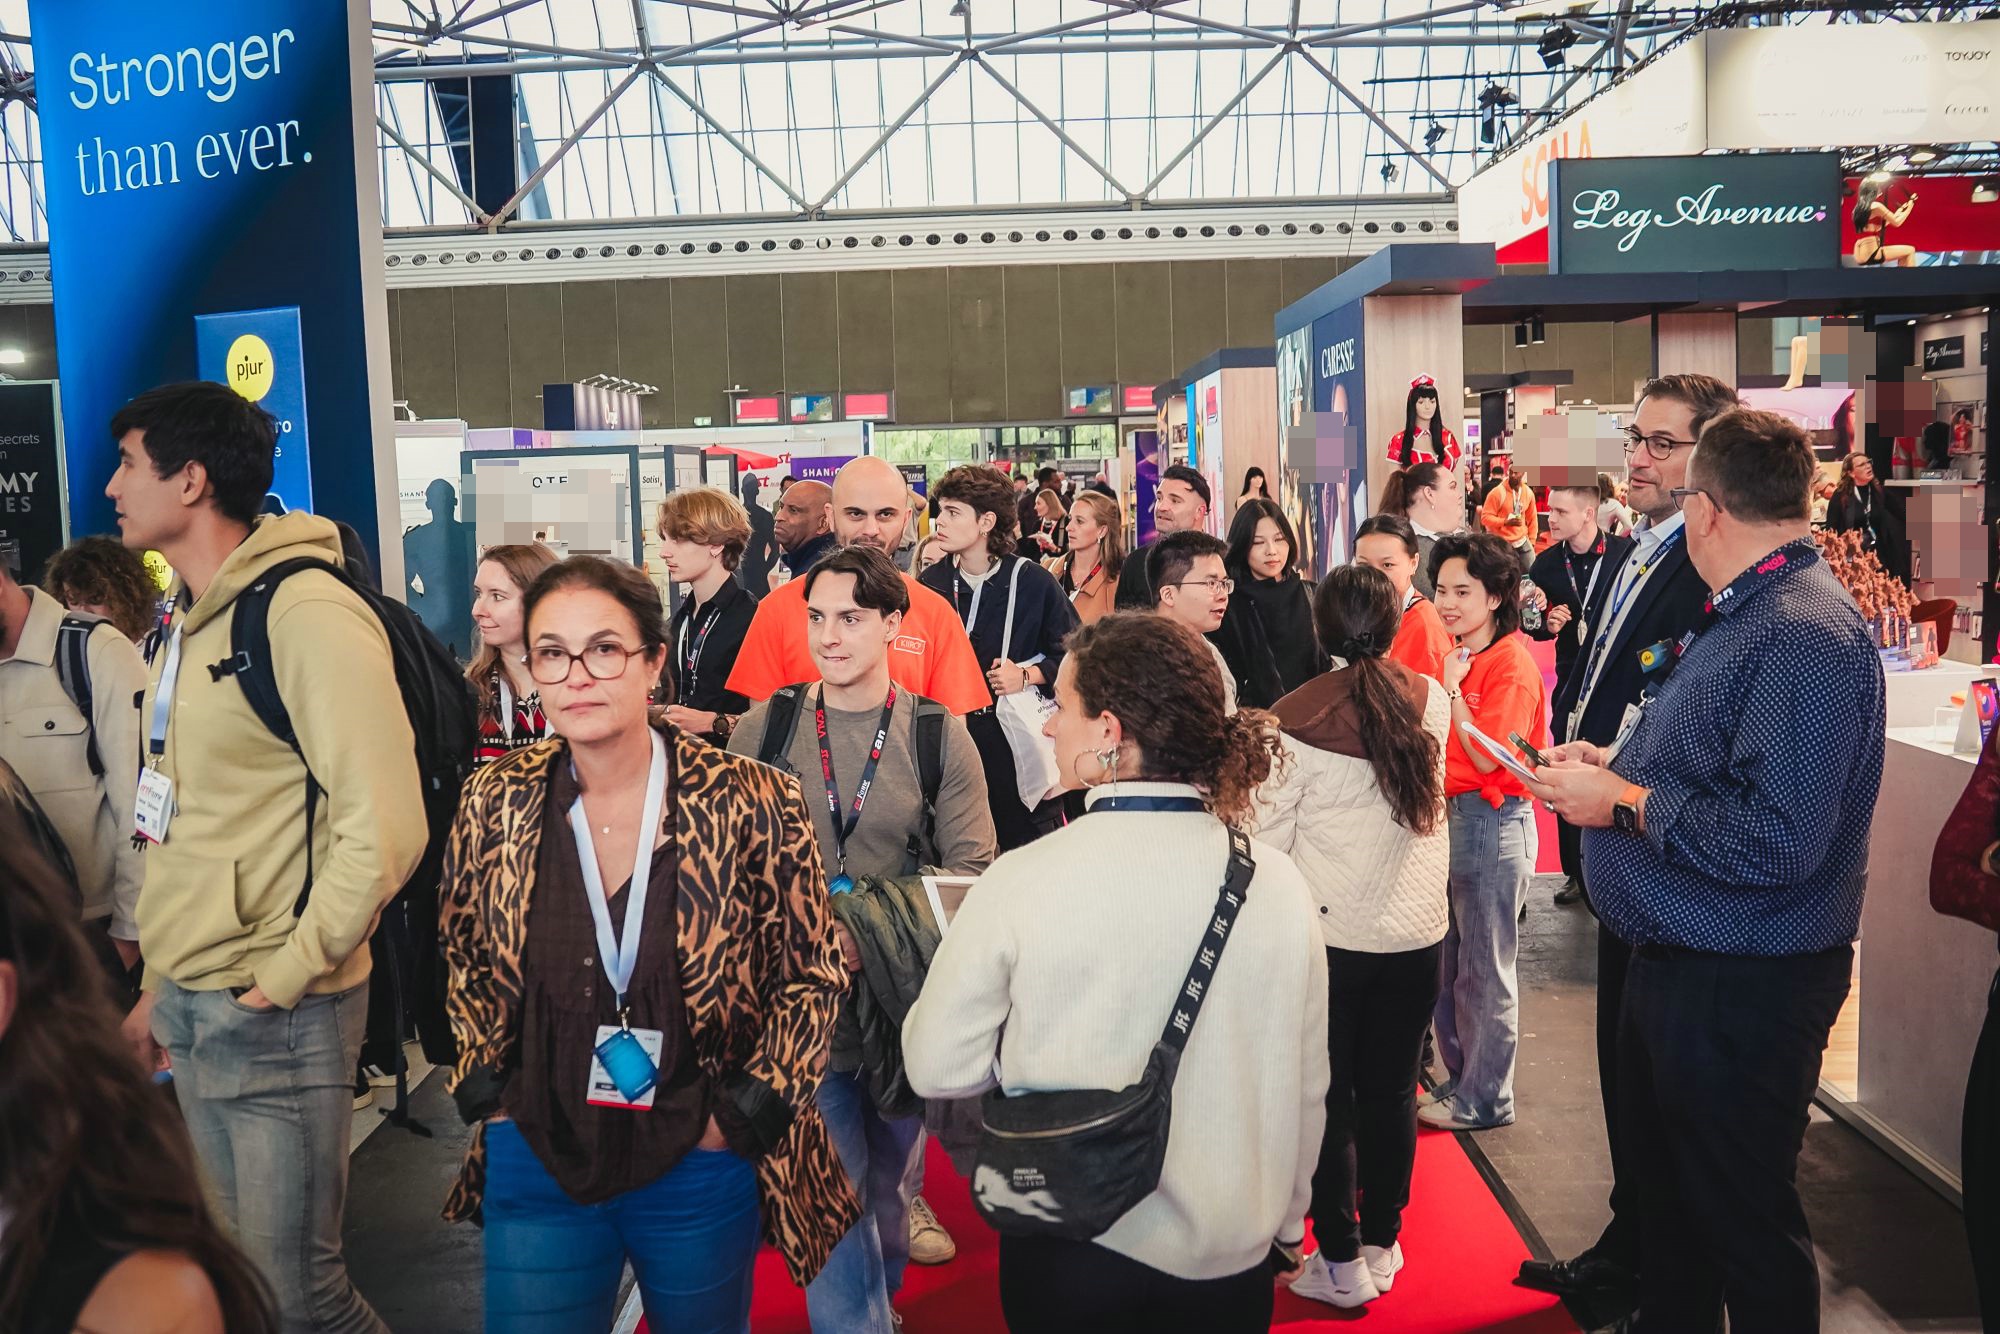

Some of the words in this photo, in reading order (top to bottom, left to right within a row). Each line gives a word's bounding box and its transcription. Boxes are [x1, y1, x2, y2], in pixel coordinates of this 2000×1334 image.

[69, 28, 295, 110] Stronger
[1944, 50, 1992, 61] TOYJOY
[75, 136, 181, 196] than
[195, 119, 313, 179] ever.
[1572, 189, 1652, 252] Leg
[1652, 184, 1816, 228] Avenue
[236, 354, 264, 382] pjur
[1321, 338, 1355, 379] CARESSE
[0, 433, 40, 445] secrets
